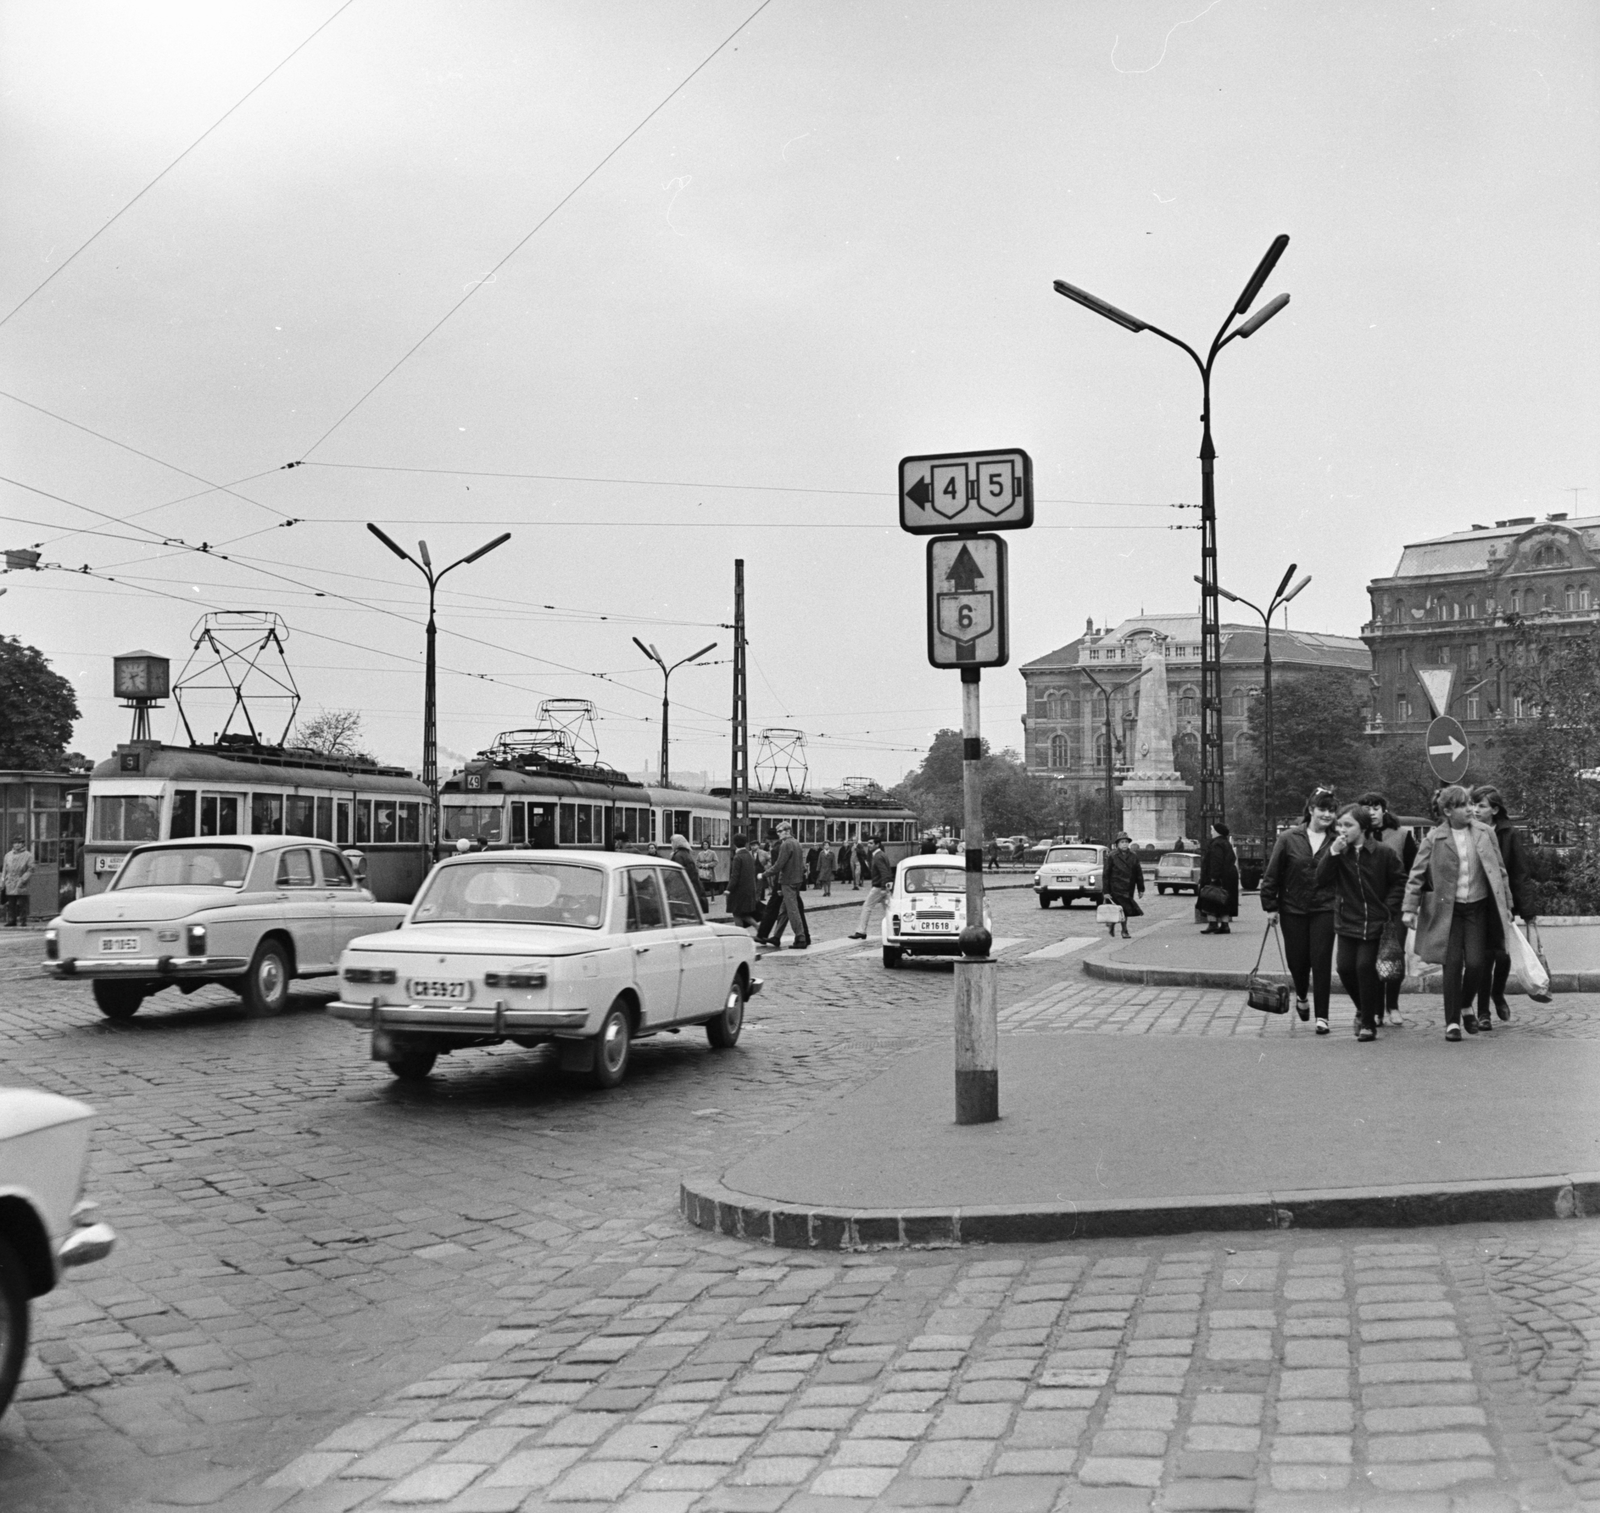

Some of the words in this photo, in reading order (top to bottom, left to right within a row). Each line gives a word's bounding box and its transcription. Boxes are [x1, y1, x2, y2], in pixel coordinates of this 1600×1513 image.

[942, 476, 958, 500] 4
[989, 473, 1004, 497] 5
[958, 603, 973, 629] 6
[126, 756, 134, 769] 9
[468, 776, 480, 788] 49
[99, 858, 105, 869] 9
